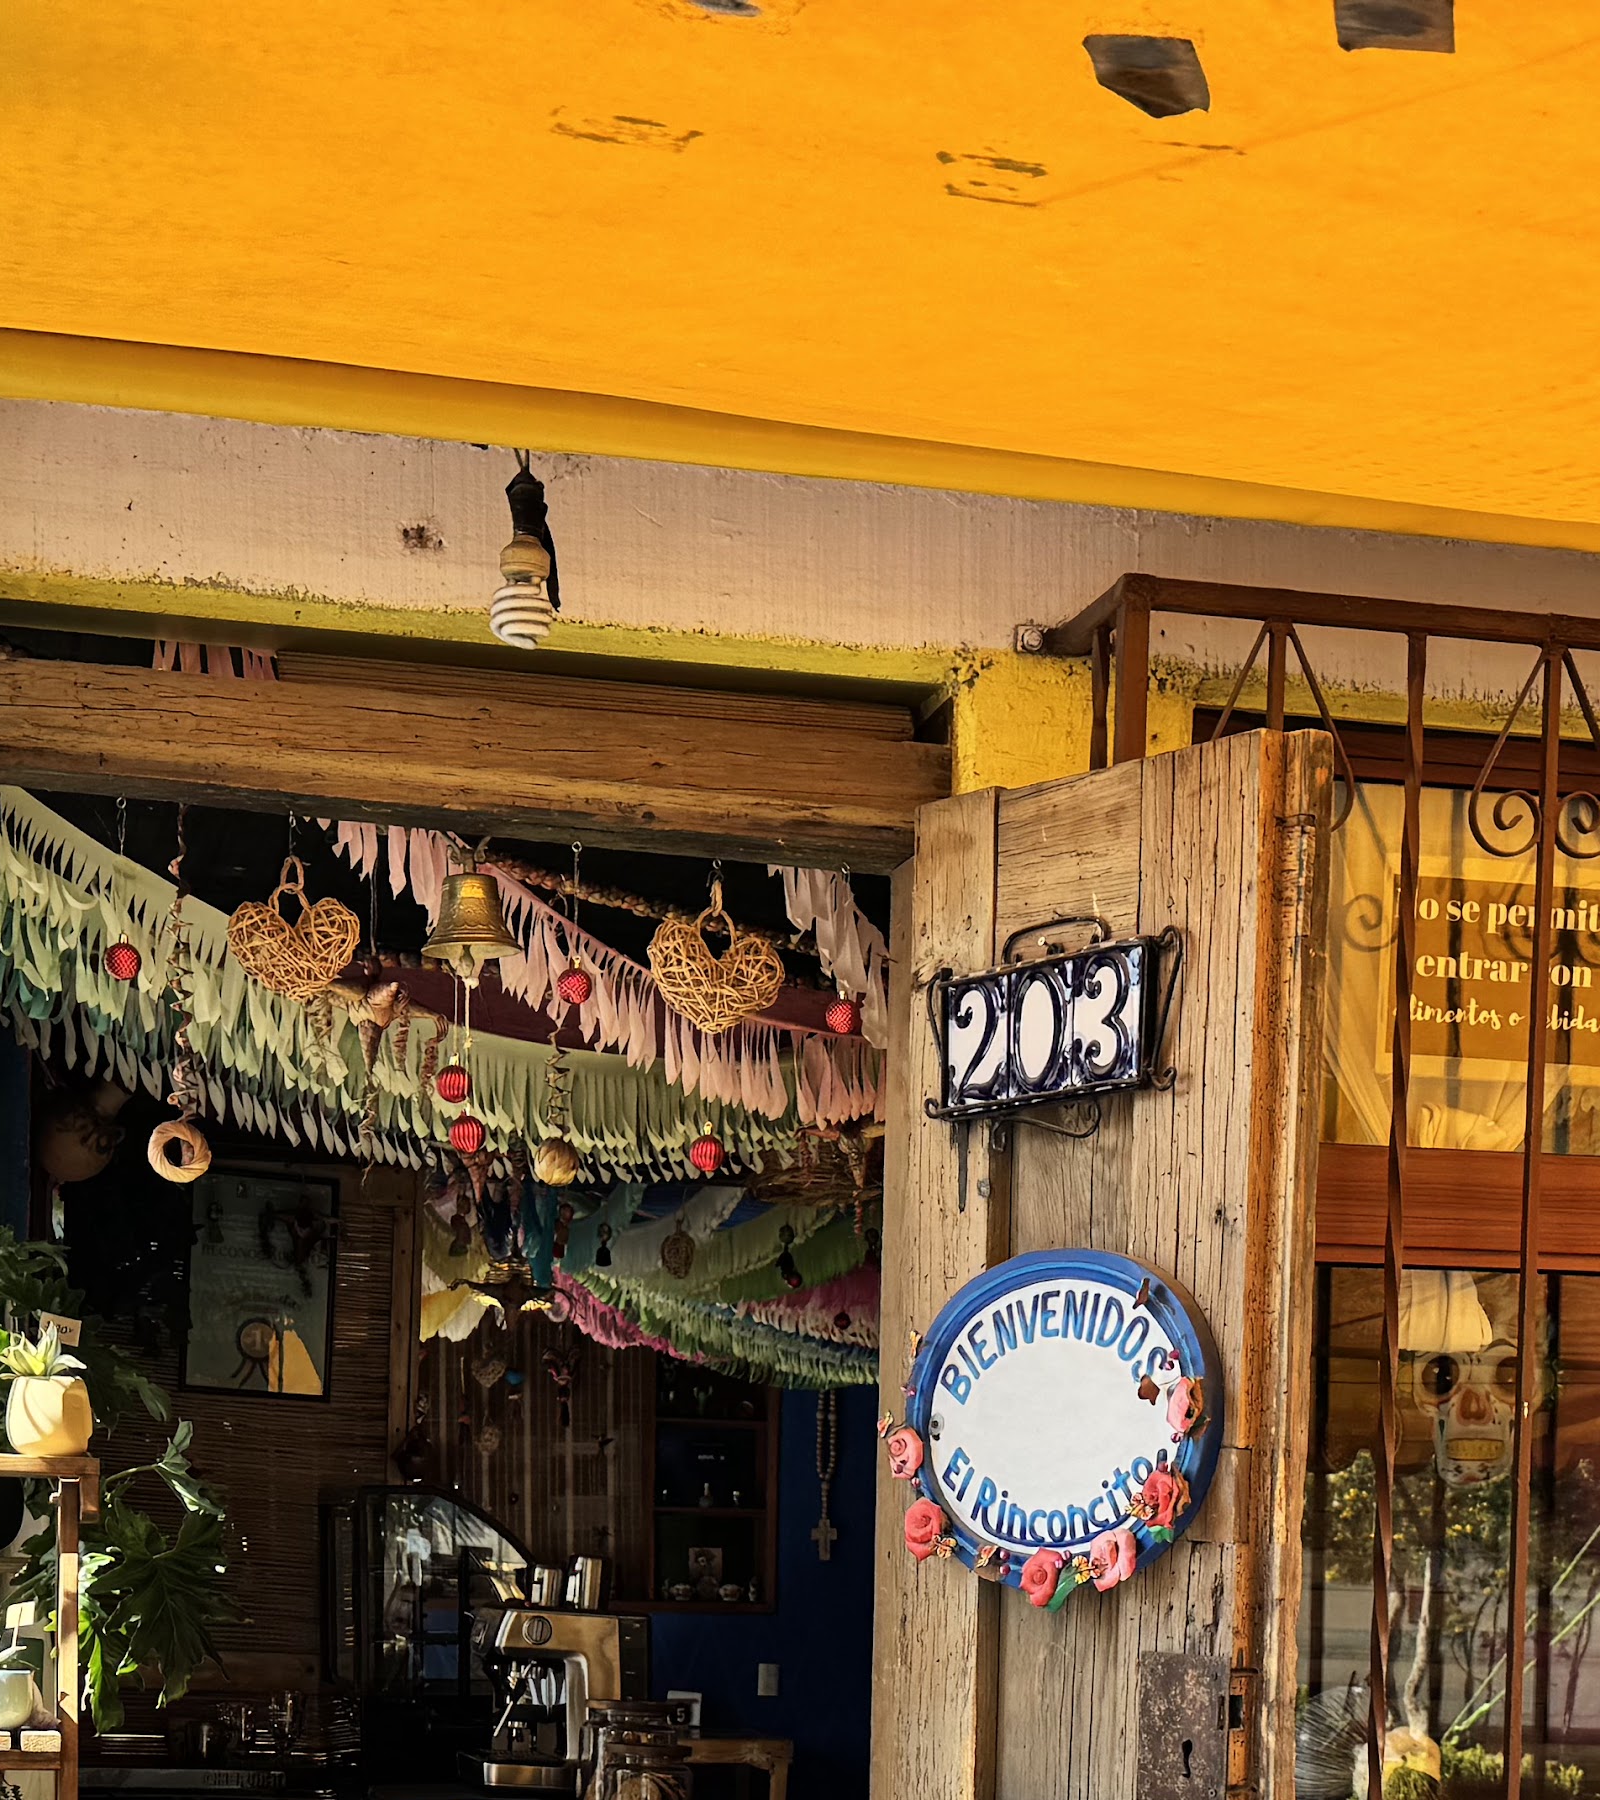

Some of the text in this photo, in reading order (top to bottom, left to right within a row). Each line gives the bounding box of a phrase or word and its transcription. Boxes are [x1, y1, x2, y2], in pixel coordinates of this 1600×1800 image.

[1445, 899, 1481, 923] se
[1415, 951, 1593, 988] entrar on
[951, 955, 1131, 1101] 203
[1393, 993, 1504, 1031] limentos
[939, 1288, 1173, 1406] BIENVENIDOS
[940, 1447, 1166, 1548] El Rinconcito
